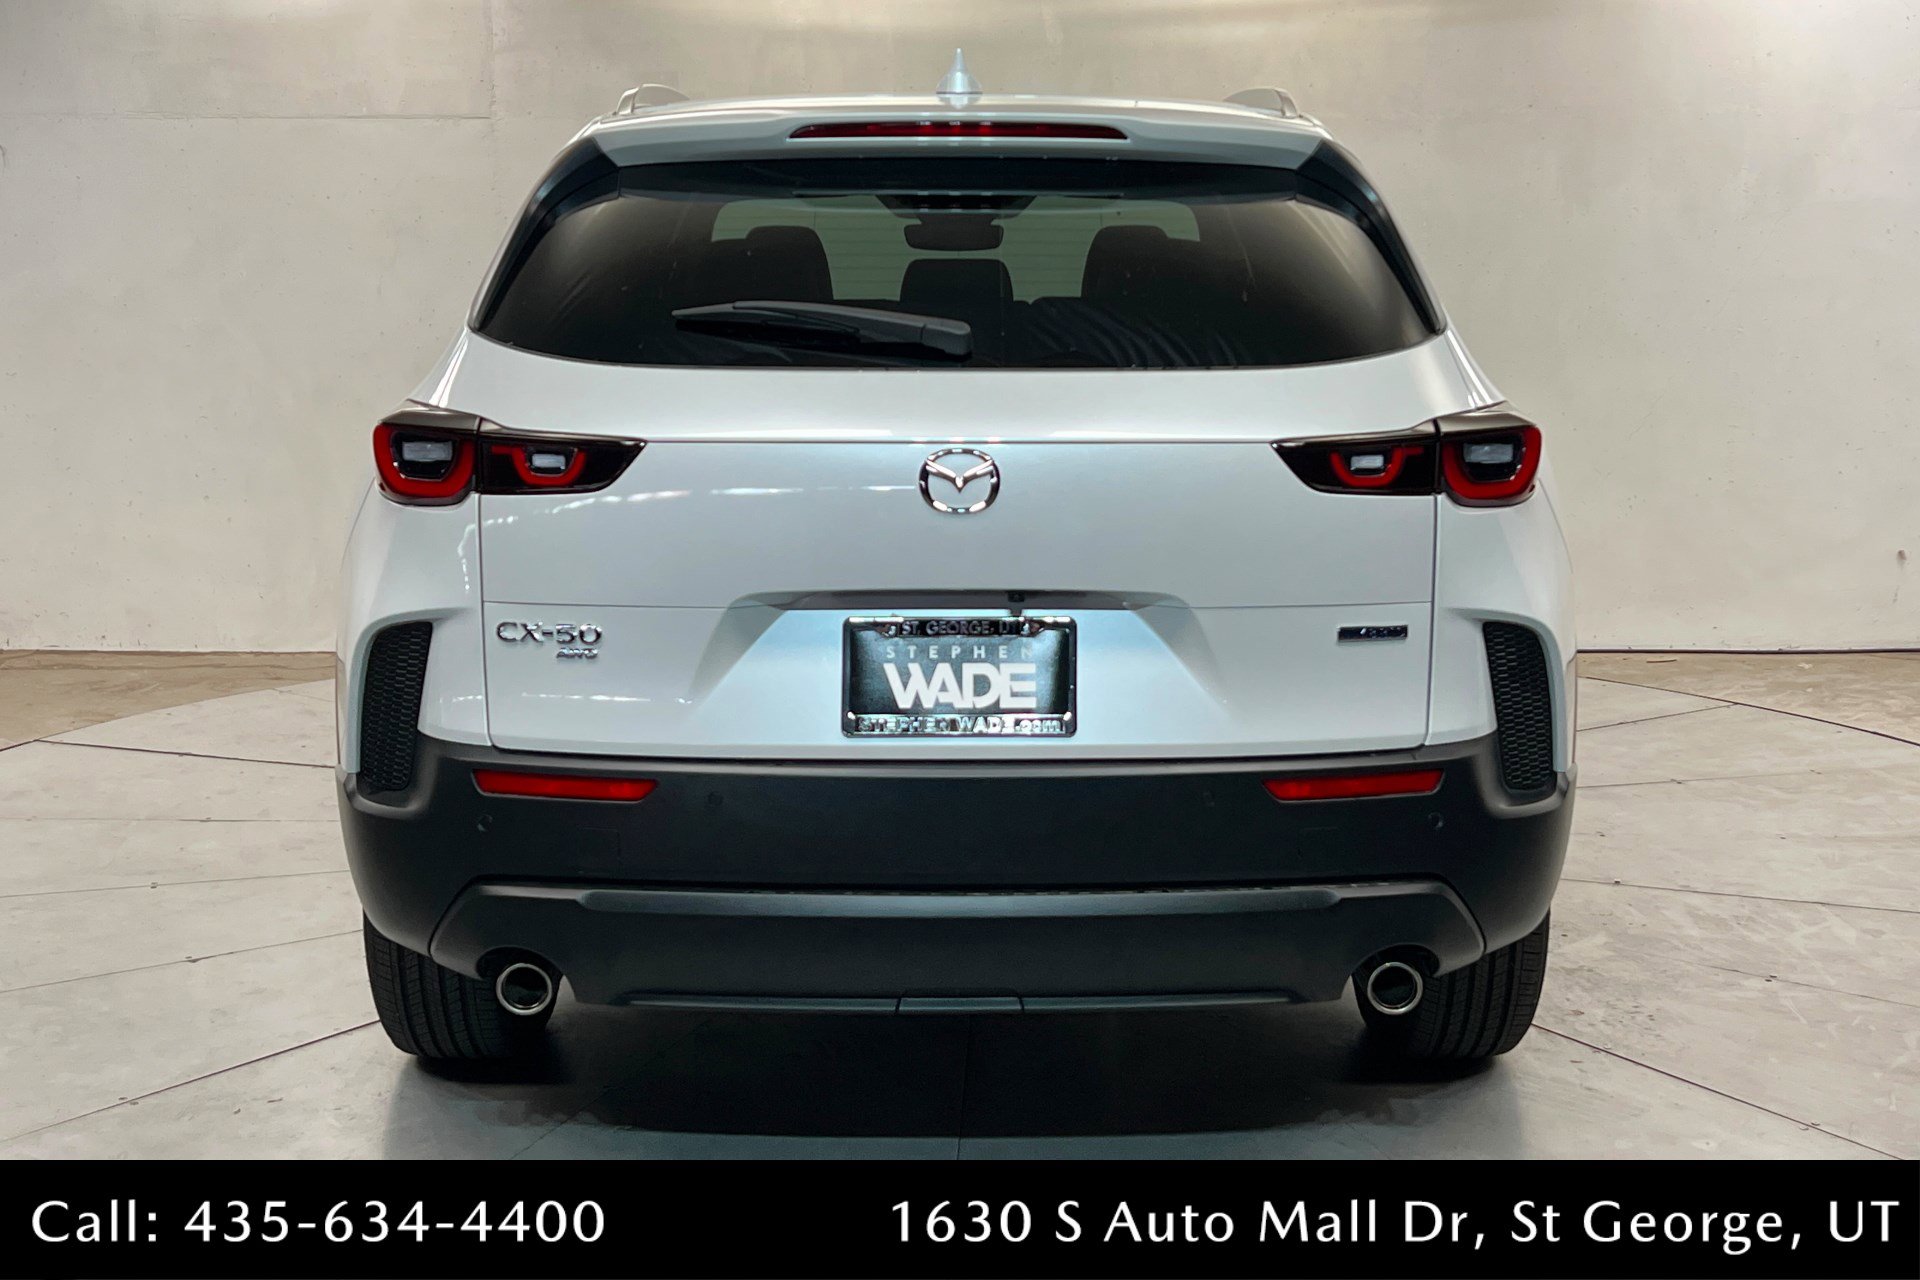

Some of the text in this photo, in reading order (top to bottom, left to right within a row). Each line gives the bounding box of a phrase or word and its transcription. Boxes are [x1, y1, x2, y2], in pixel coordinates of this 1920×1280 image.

[496, 621, 602, 645] CX-50
[886, 645, 1033, 659] STEPHEN
[883, 663, 1037, 709] WADE
